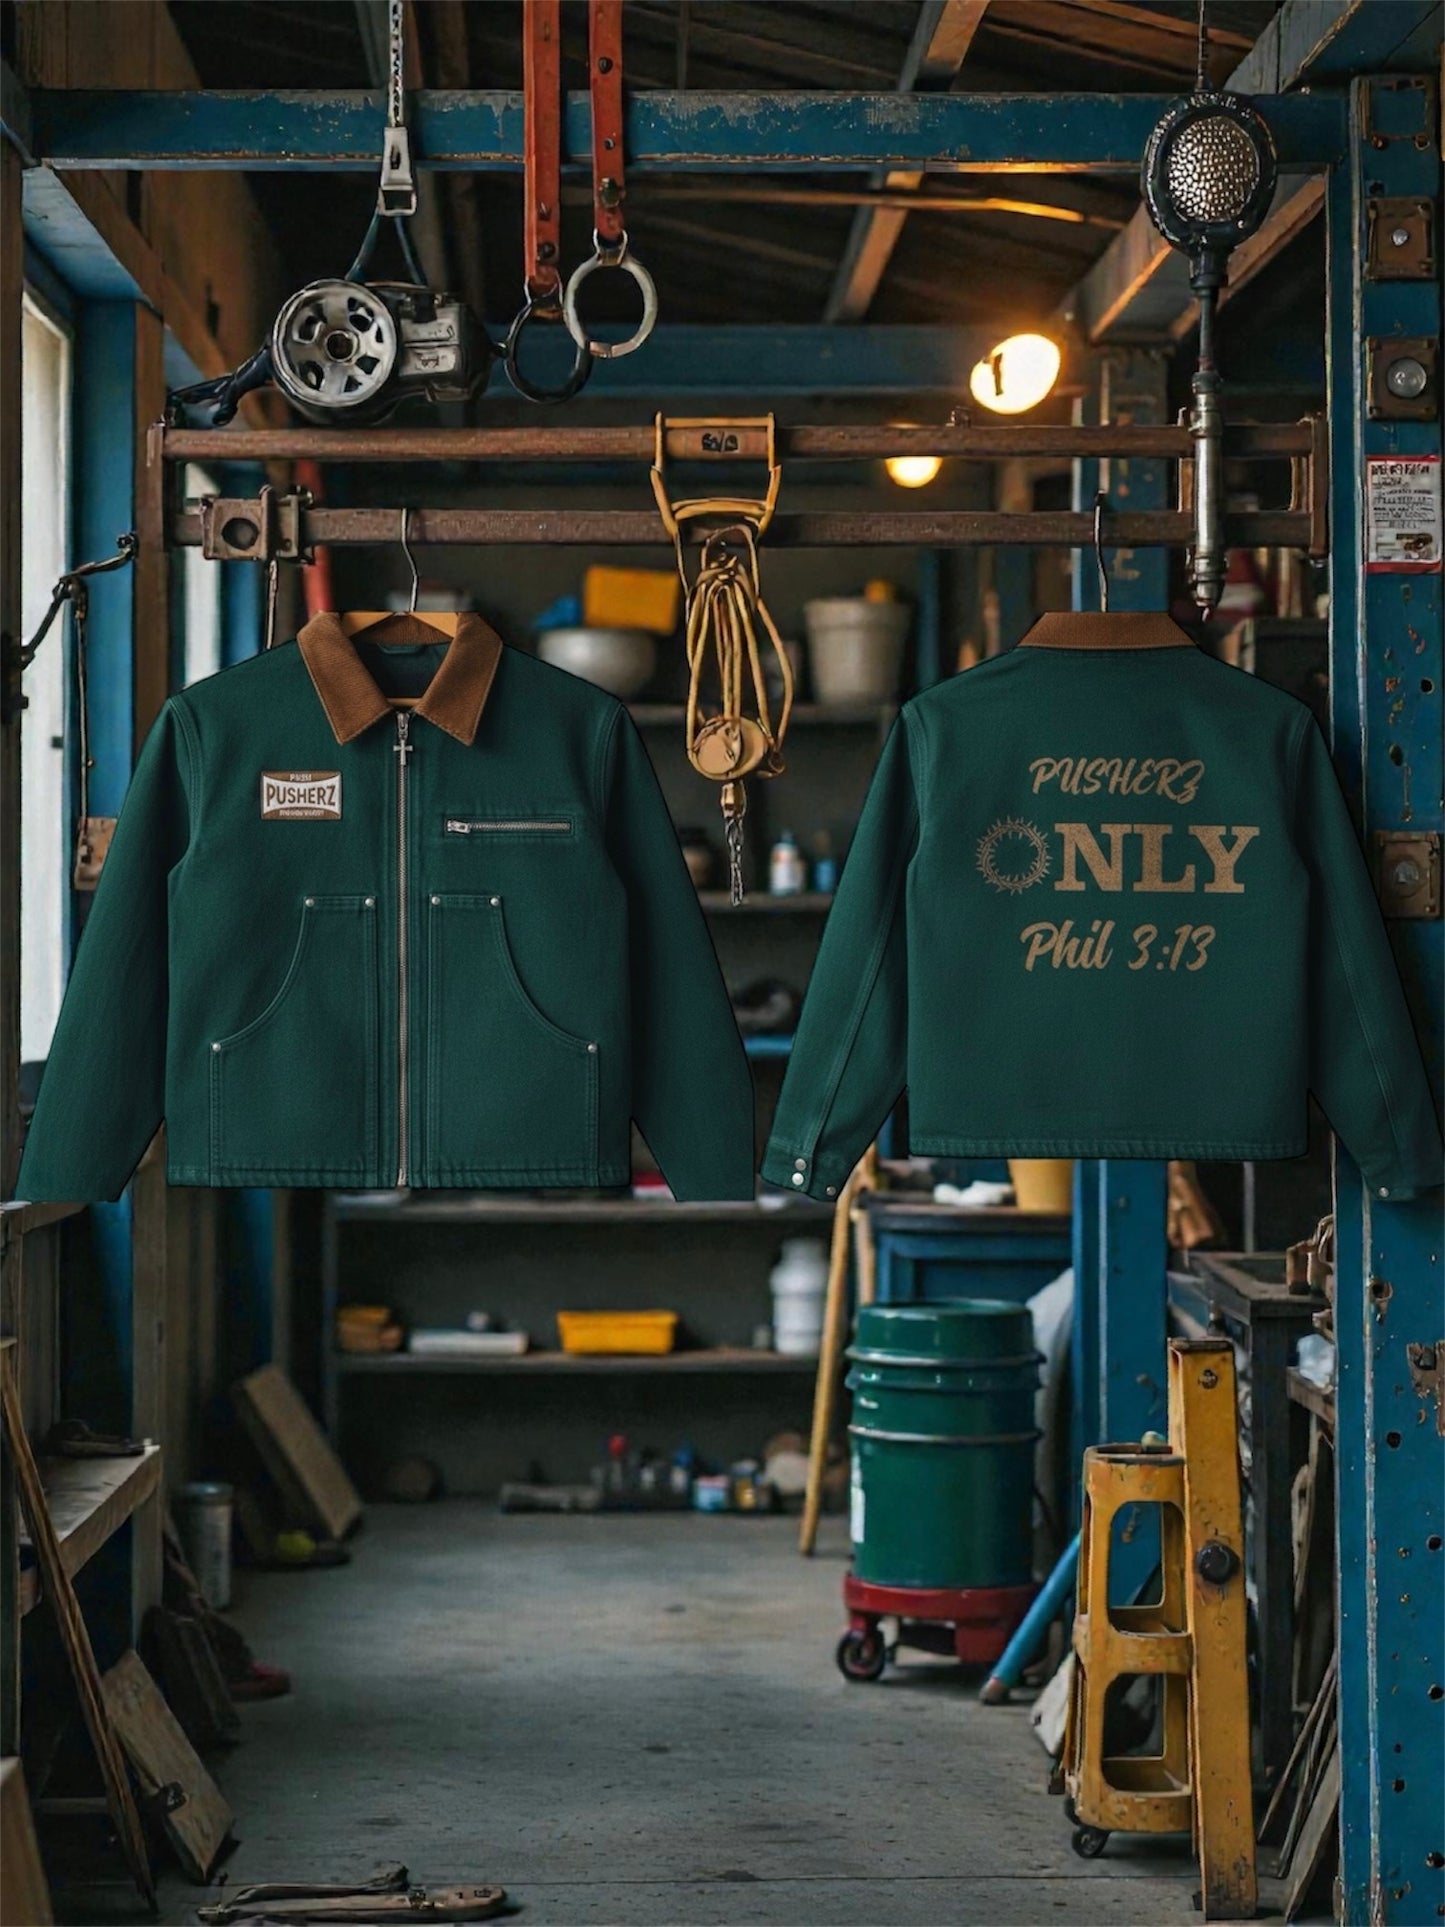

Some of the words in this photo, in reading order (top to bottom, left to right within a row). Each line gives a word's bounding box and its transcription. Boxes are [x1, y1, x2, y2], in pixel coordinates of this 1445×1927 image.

[266, 783, 336, 806] PUSHERZ
[1029, 757, 1205, 804] PUSHERZ
[1020, 919, 1116, 971] Phil
[1128, 923, 1216, 971] 3:13
